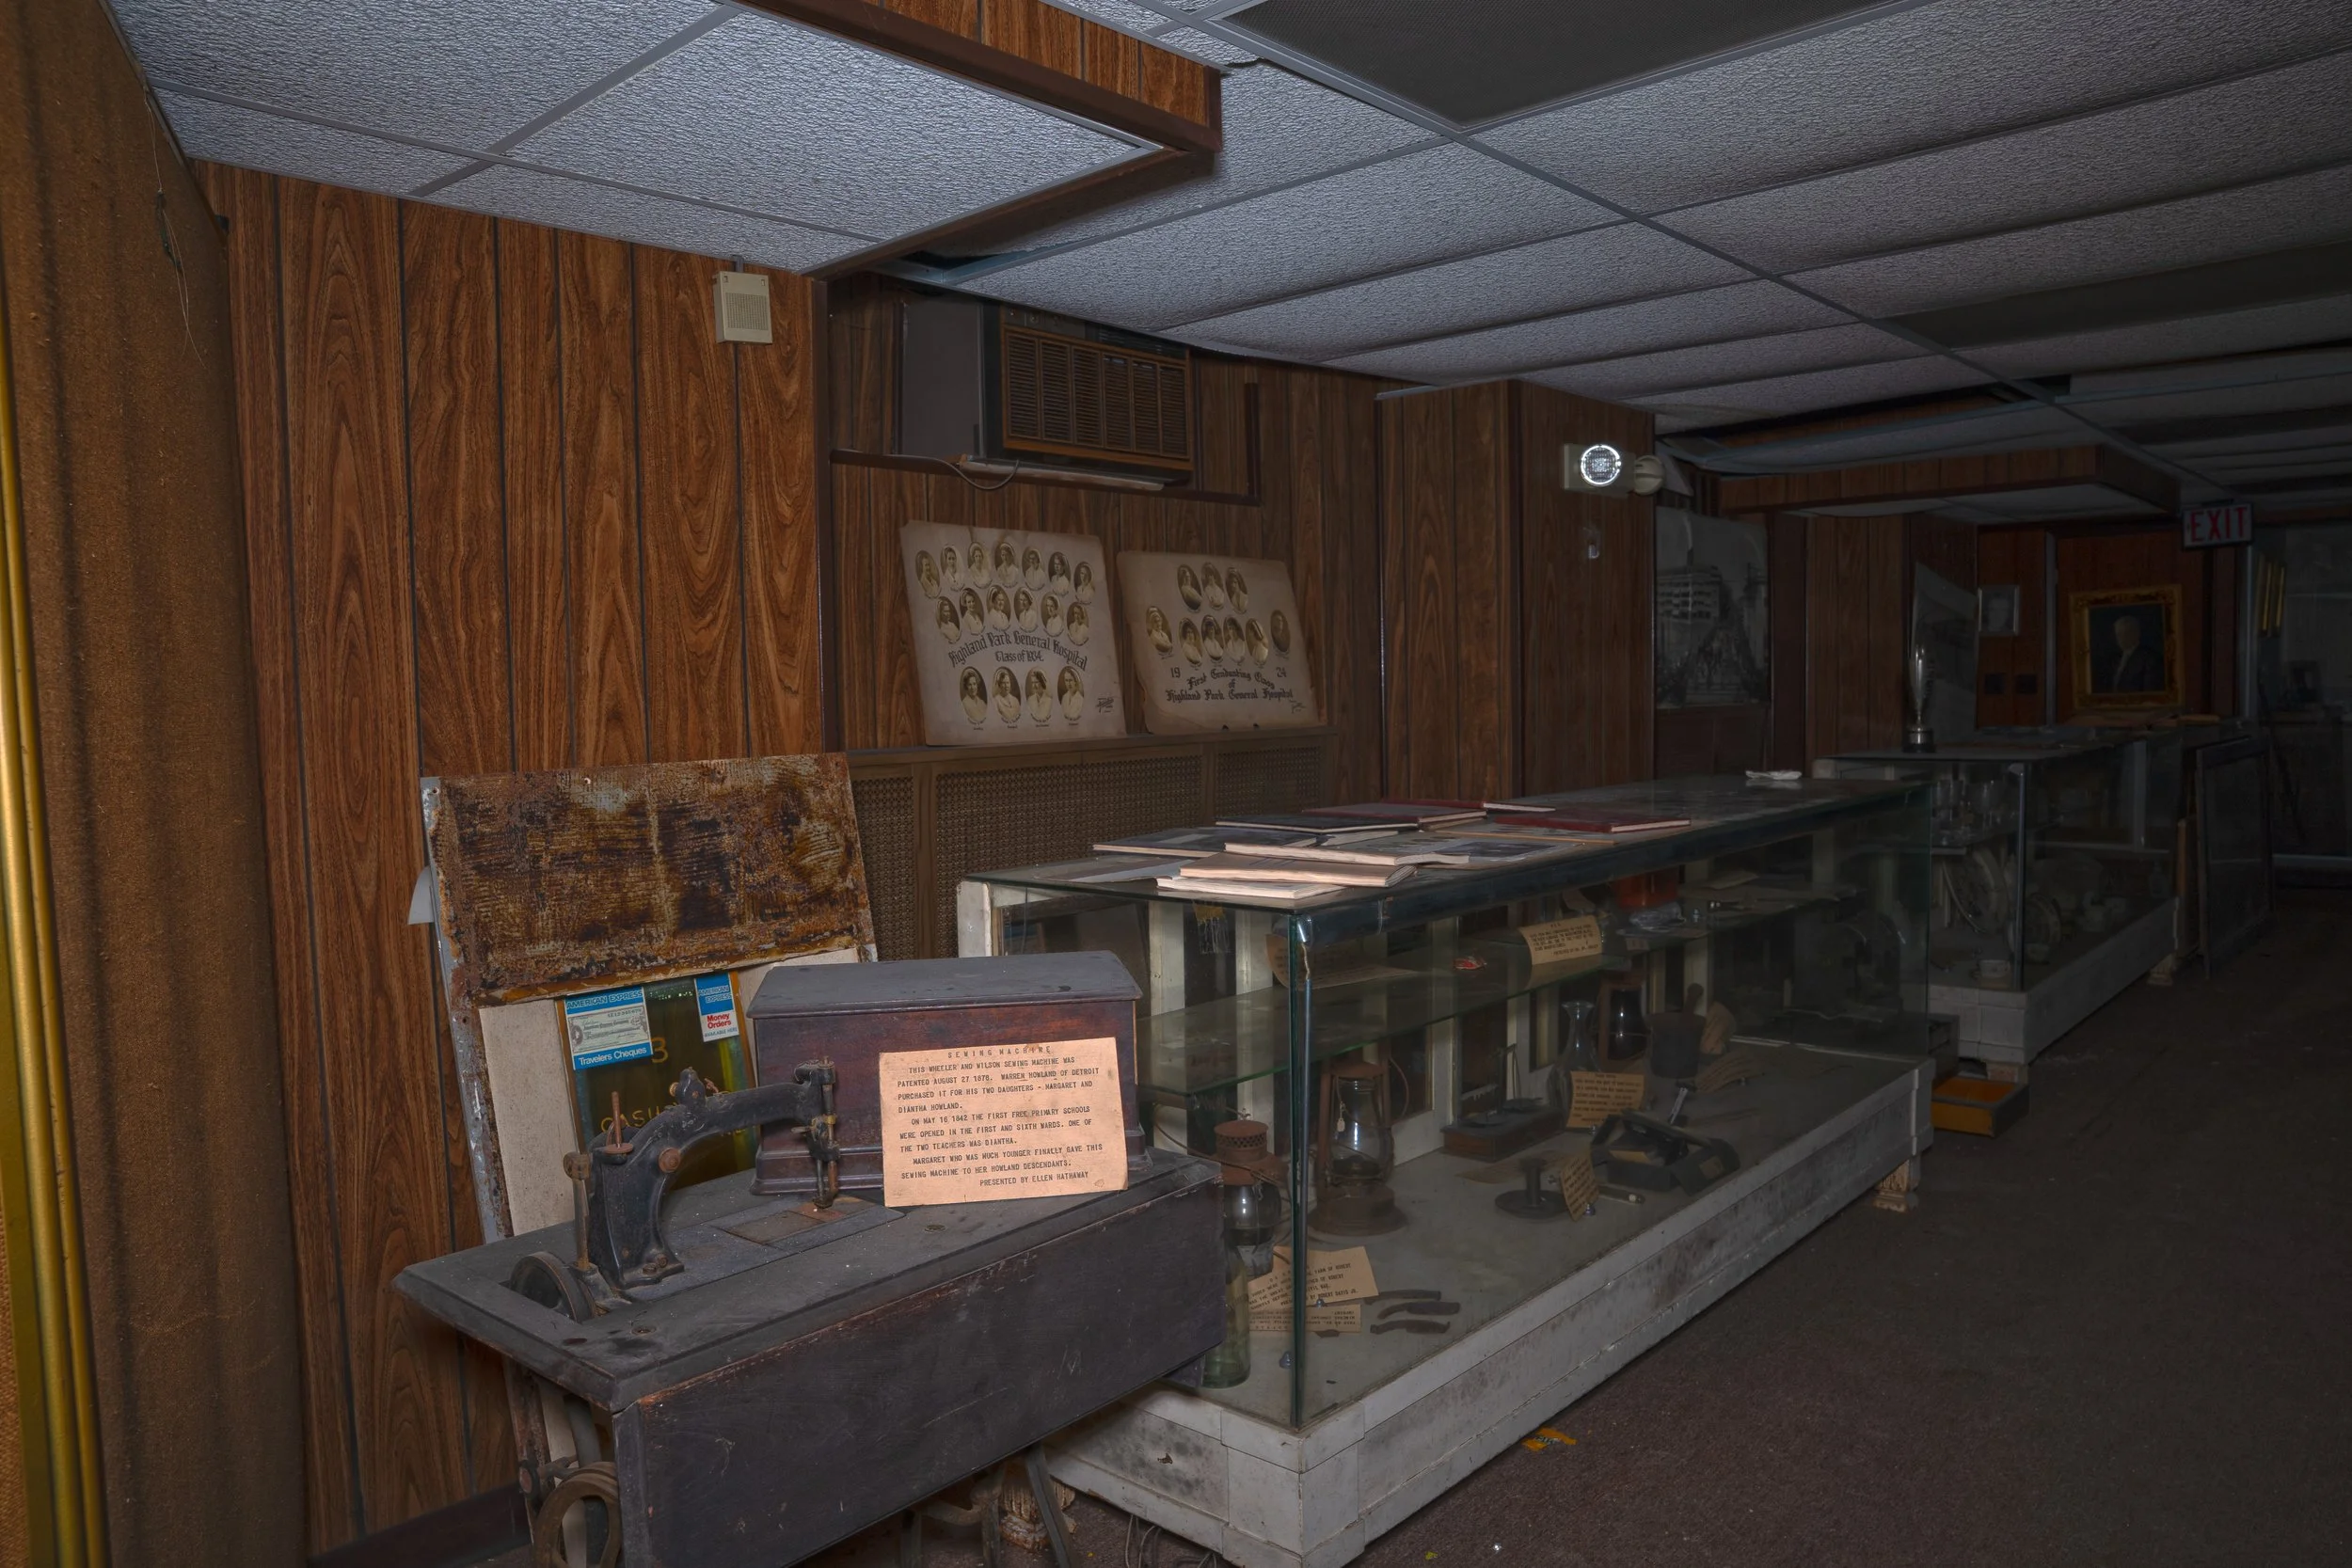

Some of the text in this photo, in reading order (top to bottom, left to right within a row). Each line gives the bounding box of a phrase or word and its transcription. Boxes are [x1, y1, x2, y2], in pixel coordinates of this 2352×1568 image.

[2190, 506, 2248, 543] EXIT
[947, 631, 1088, 671] Highland Park General Hospital
[994, 650, 1016, 662] Class
[1017, 650, 1027, 662] of
[1170, 667, 1181, 678] 19
[1186, 673, 1207, 690] First
[1166, 689, 1201, 704] Highland
[566, 990, 643, 1009] AMERICAN EXPRESS
[707, 1013, 730, 1022] Money
[707, 1021, 732, 1029] Orders
[579, 1047, 647, 1066] Travelers Cheques
[651, 1037, 669, 1064] 3
[929, 1064, 958, 1072] WHEELER
[1004, 1059, 1028, 1068] SEWING
[1032, 1057, 1059, 1066] MACHINE
[898, 1079, 930, 1087] PATENTED
[933, 1076, 958, 1085] AUGUST
[1001, 1072, 1025, 1081] WARREN
[1028, 1070, 1057, 1079] HOWLAND
[1072, 1068, 1100, 1076] DETROIT
[898, 1091, 935, 1101] PURCHASED
[997, 1085, 1034, 1093] DAUGHTERS
[1045, 1081, 1077, 1090] MARGARET
[898, 1101, 962, 1114] DIANTHA HOWLAND.
[923, 1117, 935, 1125] MAY
[1011, 1110, 1028, 1118] FREE
[1031, 1108, 1059, 1117] PRIMARY
[1063, 1105, 1090, 1115] SCHOOLS
[899, 1132, 916, 1140] WERE
[920, 1130, 945, 1138] OPENED
[977, 1125, 996, 1133] FIRST
[1041, 1120, 1064, 1129] WARDS.
[900, 1145, 913, 1153] THE
[932, 1140, 965, 1149] TEACHERS
[985, 1137, 1017, 1146] DIANTHA.
[913, 1155, 946, 1164] MARGARET
[982, 1151, 999, 1160] MUCH
[1002, 1149, 1031, 1158] YOUNGER
[1034, 1148, 1062, 1156] FINALLY
[1066, 1145, 1083, 1153] GAVE
[1087, 1143, 1103, 1151] THIS
[901, 1160, 1072, 1180] SEWING MACHINE TO HER HOWLAND DESCENDANTS.
[979, 1177, 1017, 1186] PRESENTED
[1032, 1174, 1054, 1182] ELLEN
[1057, 1171, 1089, 1180] HATHAWAY
